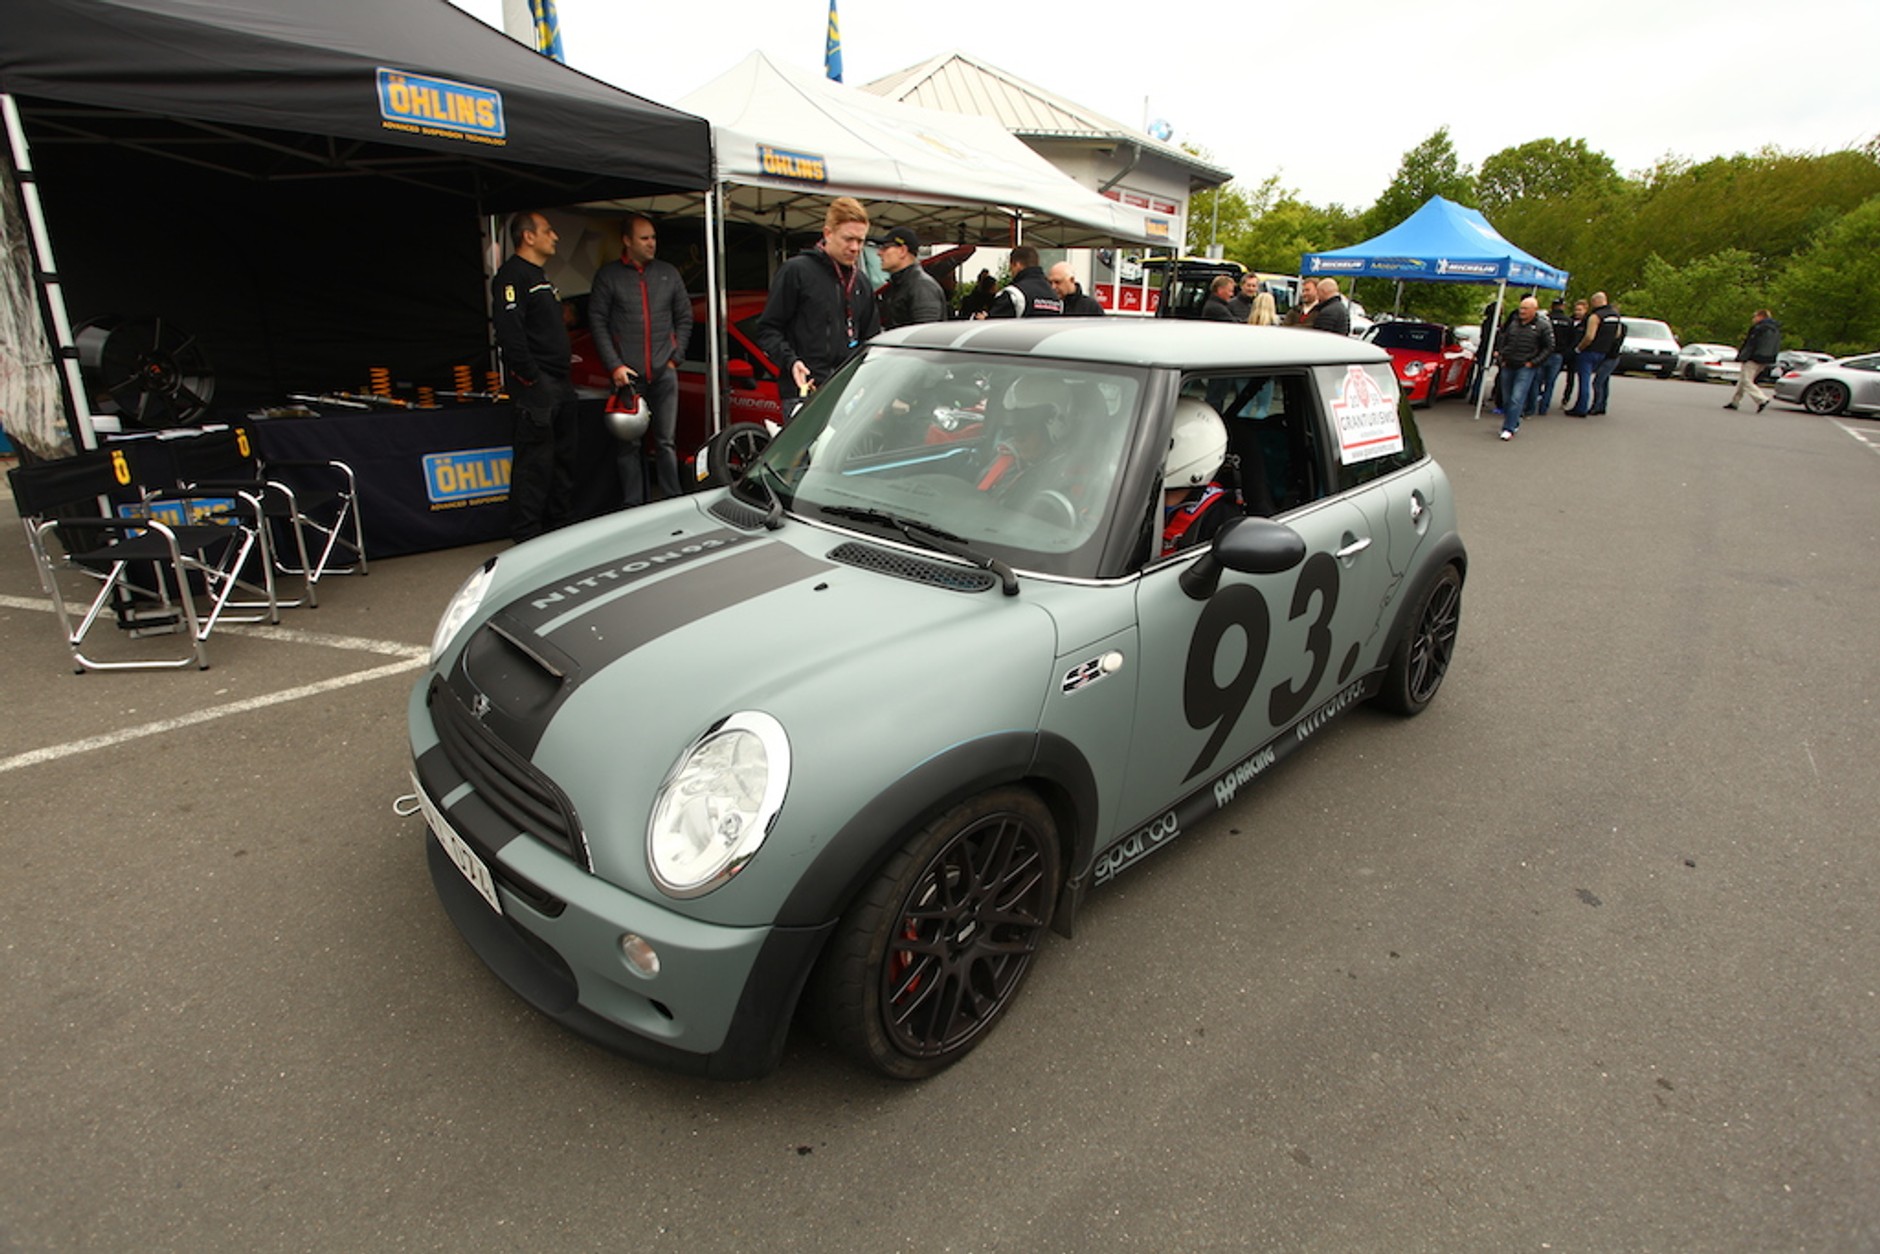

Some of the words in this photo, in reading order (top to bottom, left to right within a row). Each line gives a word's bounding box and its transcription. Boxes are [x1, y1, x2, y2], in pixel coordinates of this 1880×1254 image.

[388, 74, 495, 128] ÖHLINS
[763, 147, 824, 181] ÖHLINS
[1447, 263, 1496, 273] MICHELIN
[1180, 551, 1360, 785] 93.
[1236, 745, 1276, 786] RACING
[1095, 811, 1179, 880] sparco
